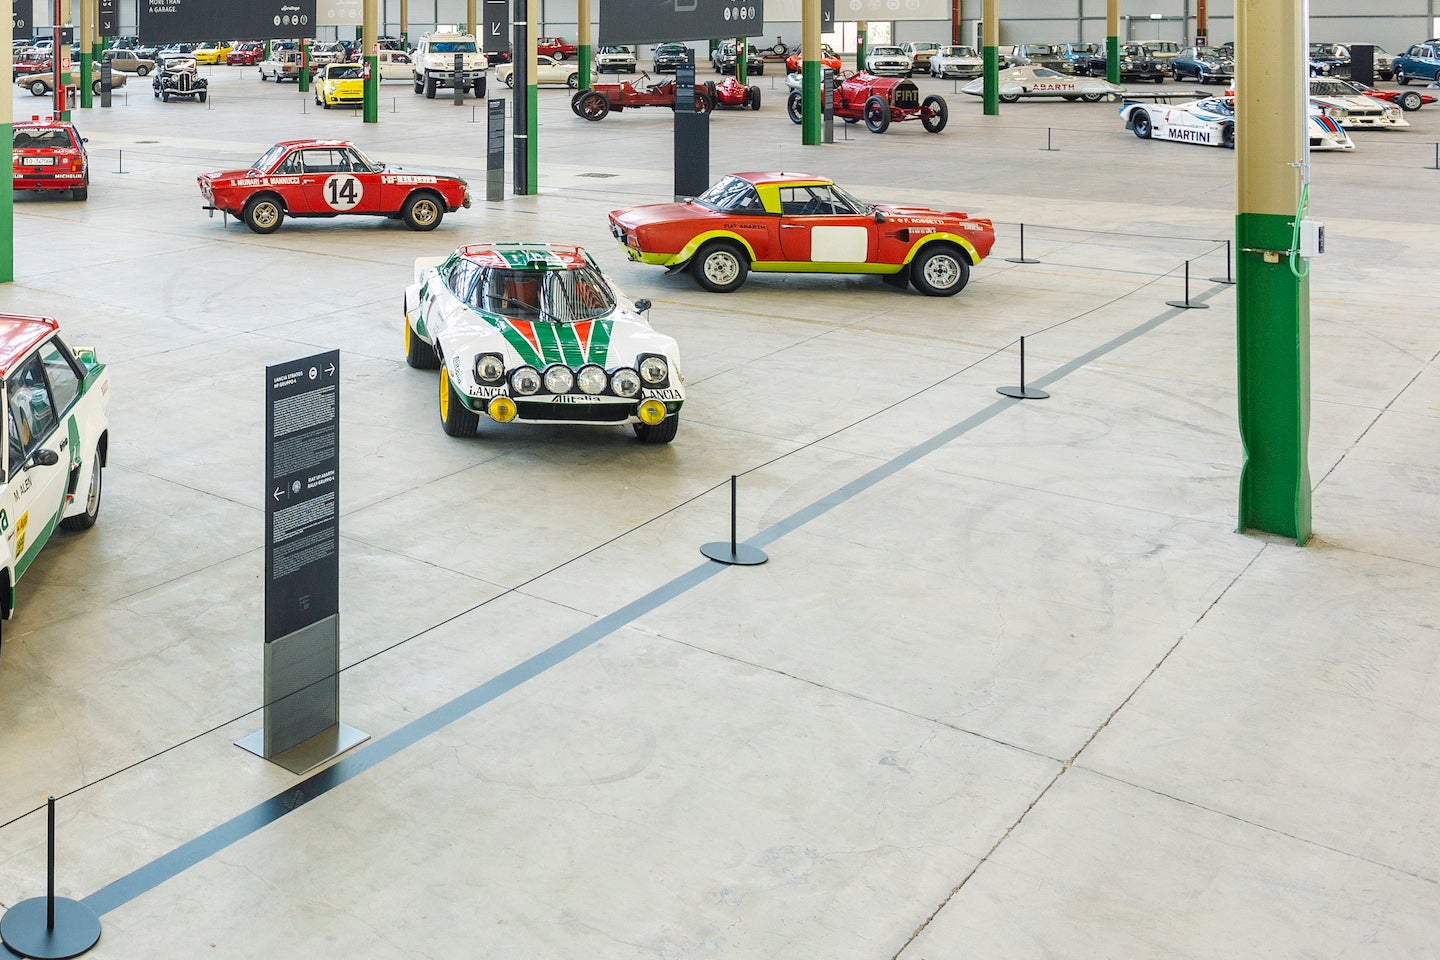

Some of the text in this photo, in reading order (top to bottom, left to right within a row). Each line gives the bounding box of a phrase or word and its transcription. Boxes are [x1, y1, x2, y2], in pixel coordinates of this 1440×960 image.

[895, 90, 918, 102] FIAT
[1168, 128, 1210, 142] MARTINI
[328, 178, 358, 205] 14
[470, 385, 509, 397] LANCIA
[642, 389, 682, 400] LANCIA
[552, 395, 601, 404] Alitalia
[13, 476, 33, 501] M. ALEN
